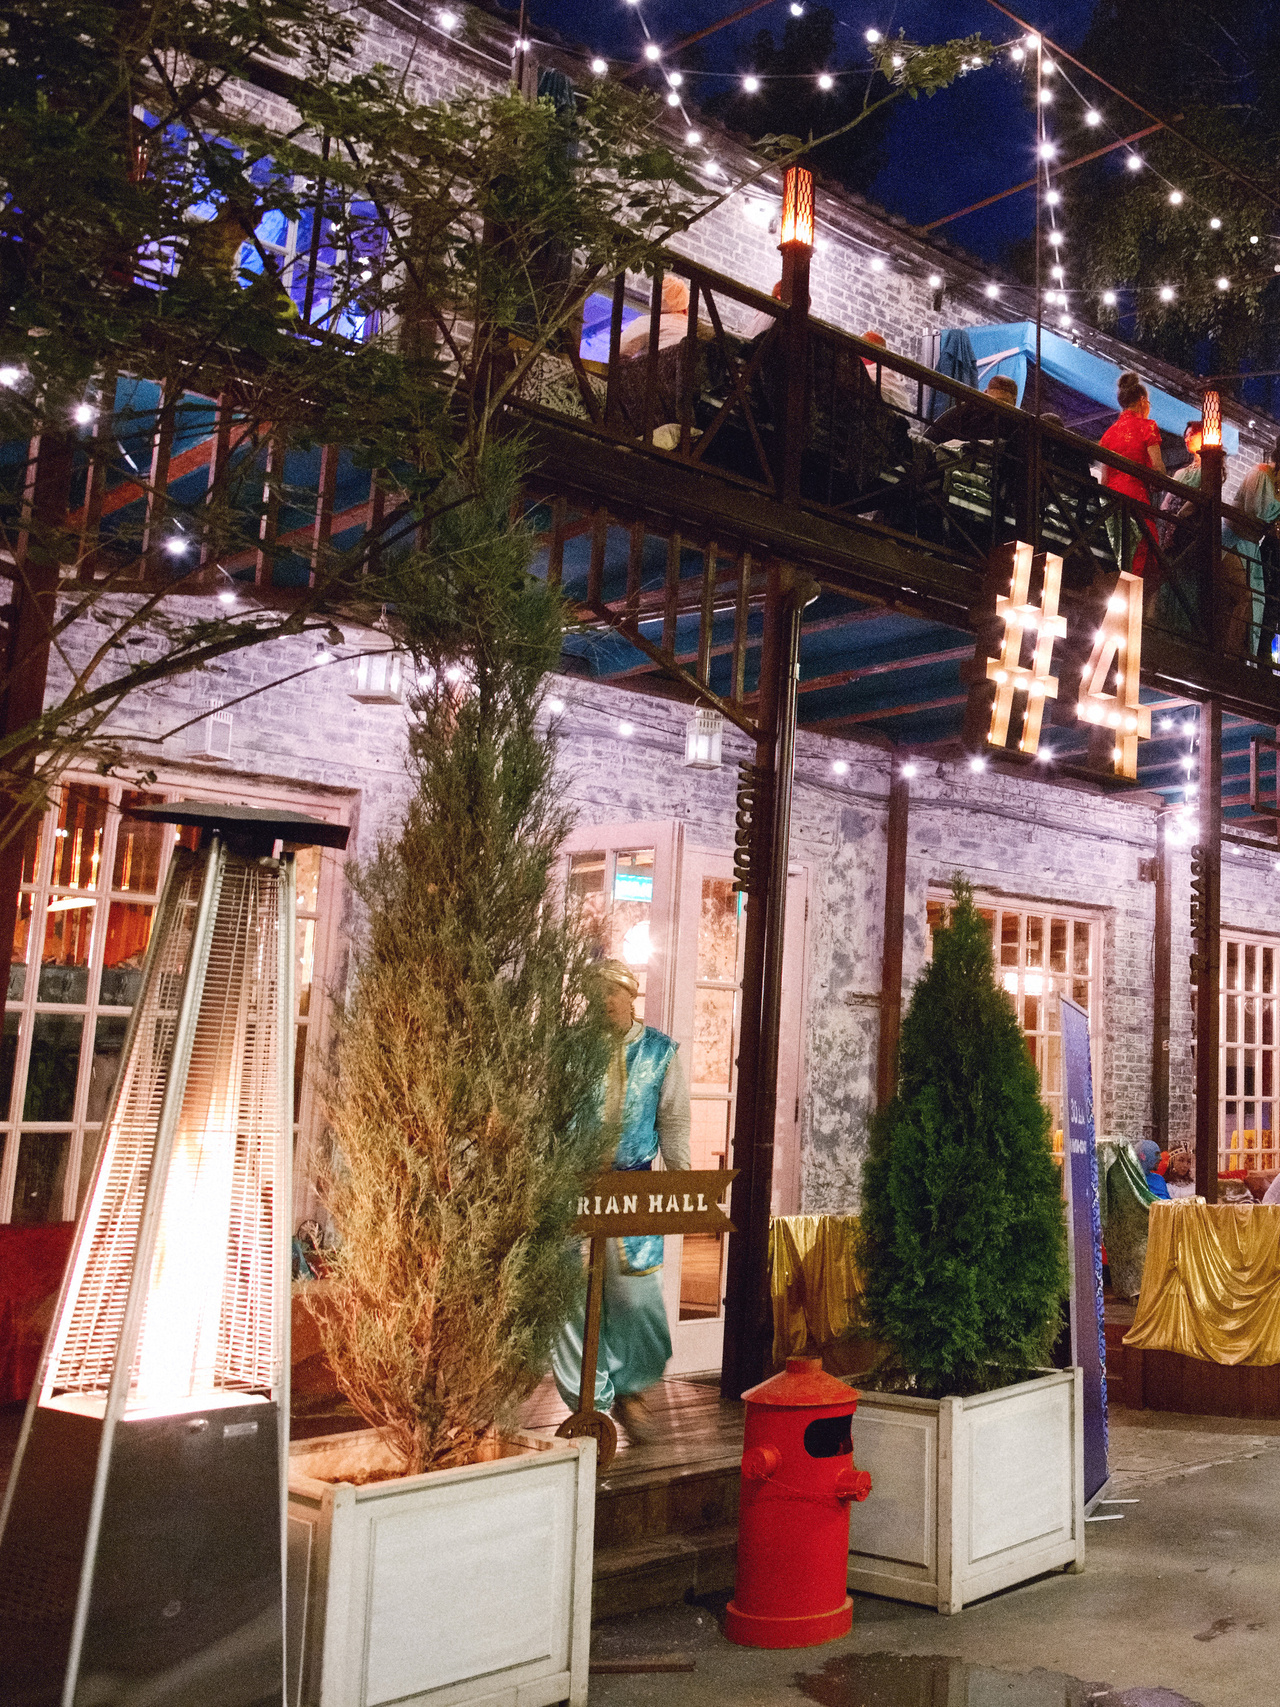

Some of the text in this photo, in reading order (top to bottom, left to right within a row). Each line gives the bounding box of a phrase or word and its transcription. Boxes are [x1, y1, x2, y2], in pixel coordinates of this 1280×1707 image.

[986, 540, 1151, 780] #4
[732, 760, 761, 893] MOSCOW
[577, 1193, 708, 1215] RIAN HALL
